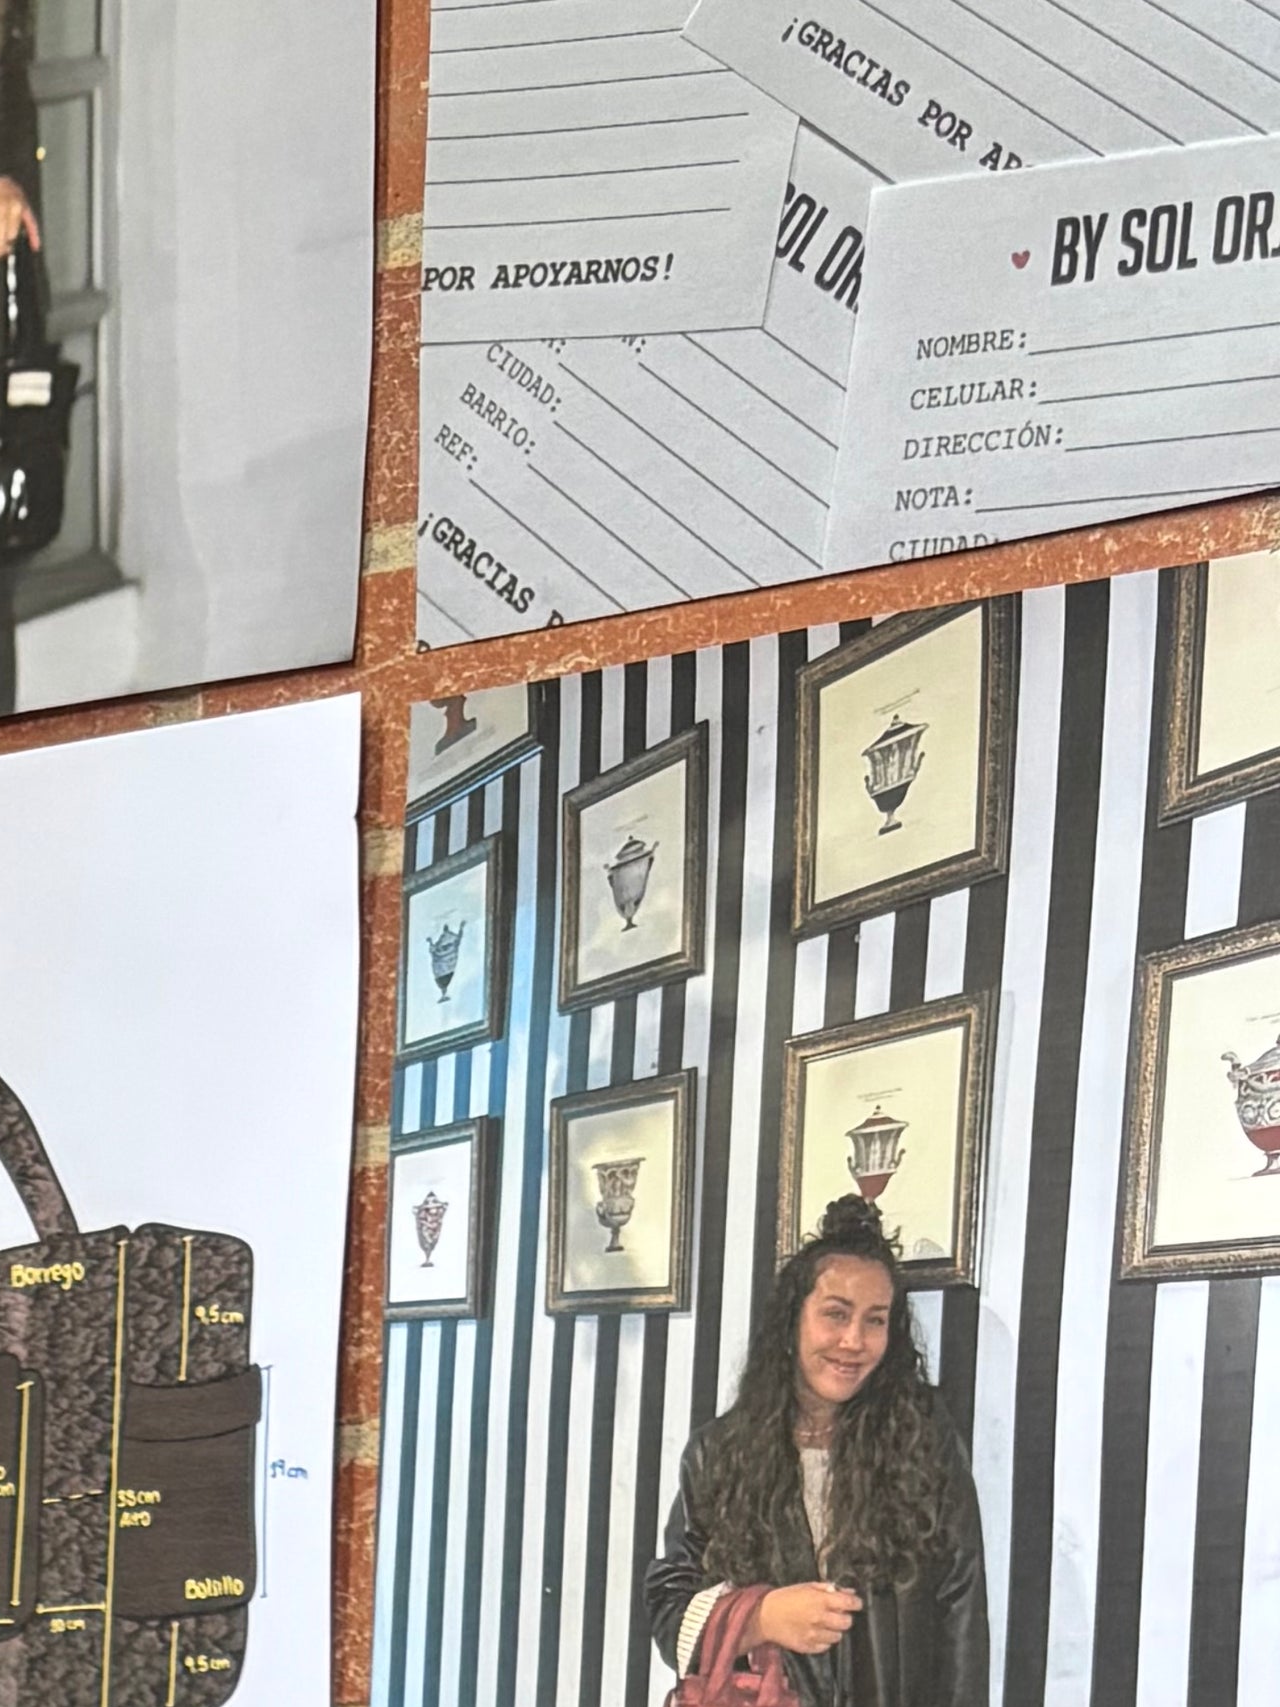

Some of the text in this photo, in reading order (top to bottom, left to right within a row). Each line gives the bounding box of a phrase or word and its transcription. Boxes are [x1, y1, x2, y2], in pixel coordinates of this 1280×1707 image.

[780, 17, 1034, 172] ¡GRACIAS POR AP
[775, 181, 829, 274] OL
[1051, 191, 1280, 286] BY SOL OR
[421, 253, 674, 291] POR APOYARNOS!
[916, 328, 1026, 360] NOMBRE:
[485, 341, 562, 413] CIUDAD:
[909, 378, 1037, 411] CELULAR:
[434, 423, 478, 471] REF:
[459, 382, 536, 455] BARRIO:
[902, 420, 1063, 461] DIRECCIÓN:
[894, 485, 973, 512] NOTA:
[417, 512, 536, 615] ¡GRACIAS
